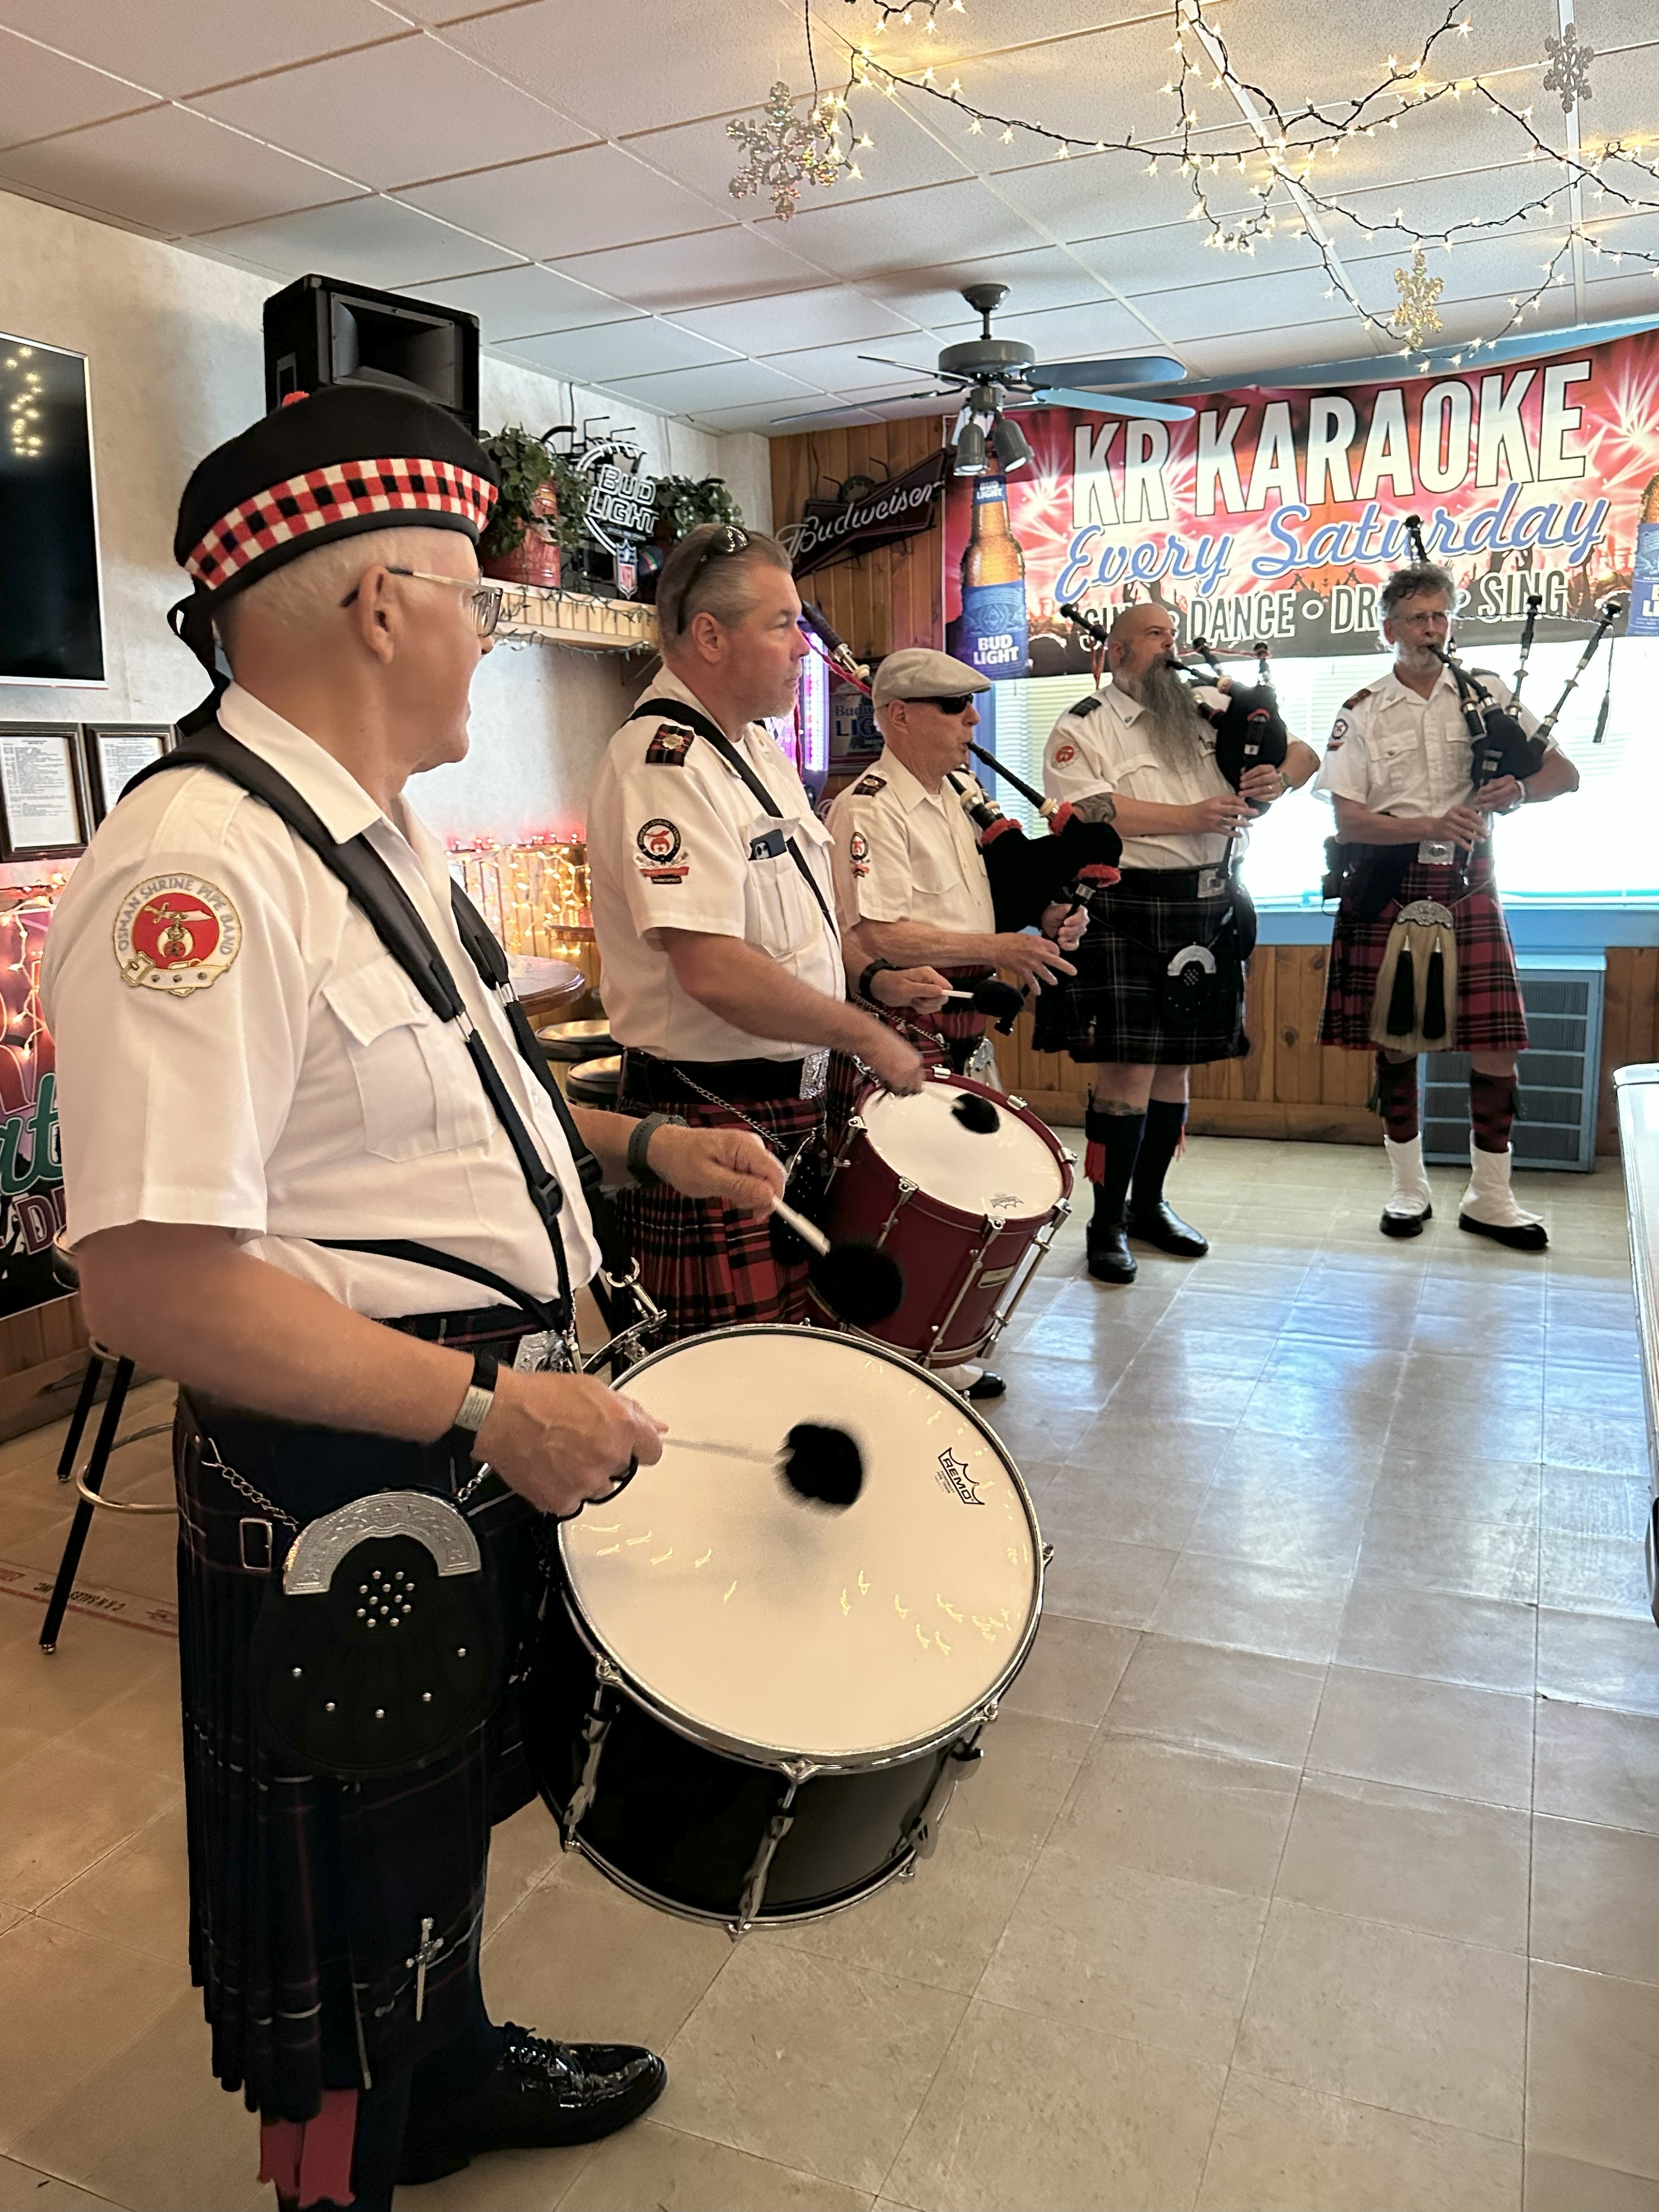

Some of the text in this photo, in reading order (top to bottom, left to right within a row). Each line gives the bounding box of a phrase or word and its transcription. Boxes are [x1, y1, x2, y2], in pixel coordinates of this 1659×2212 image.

[1073, 360, 1591, 529] KR KARAOKE
[599, 463, 656, 505] BUD
[976, 488, 1003, 499] LIGHT
[586, 486, 660, 534] LIGHT
[775, 480, 946, 559] Budweiser
[1055, 482, 1610, 603] Every Saturday
[1187, 590, 1296, 644] DANCE
[1477, 571, 1568, 623] SING
[973, 646, 1019, 665] LIGHT
[978, 634, 1013, 651] BUD
[836, 718, 876, 736] LIG
[118, 878, 235, 955] OSMAN SHRINE PIPE BAND
[943, 1458, 972, 1499] REMO
